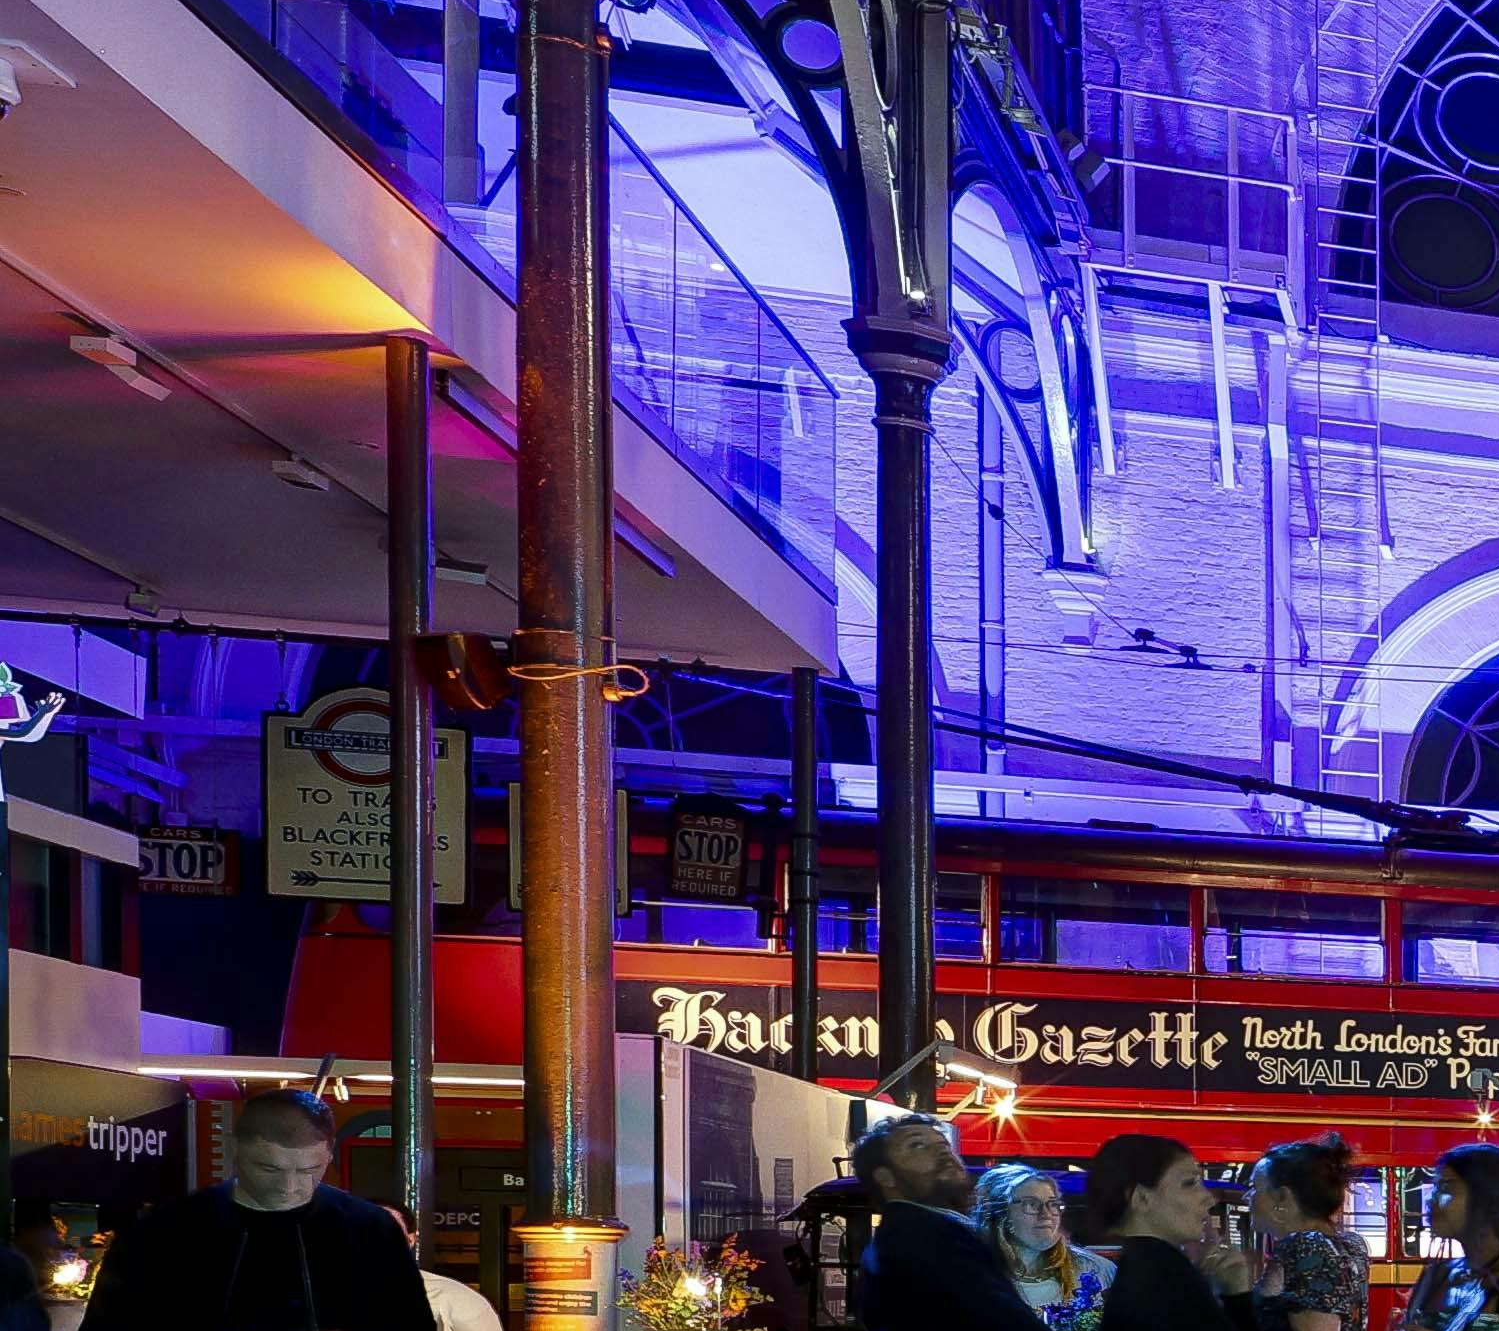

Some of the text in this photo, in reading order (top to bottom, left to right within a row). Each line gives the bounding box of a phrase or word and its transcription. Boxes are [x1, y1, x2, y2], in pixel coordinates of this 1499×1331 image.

[297, 787, 332, 805] TO
[681, 814, 737, 830] CARS
[151, 827, 201, 840] CARS
[677, 830, 740, 867] STOP
[678, 868, 732, 882] HERE IF
[672, 882, 736, 898] REQUIRED
[973, 1002, 1228, 1070] Gazette
[1242, 1016, 1324, 1051] North
[1334, 1019, 1453, 1056] London's
